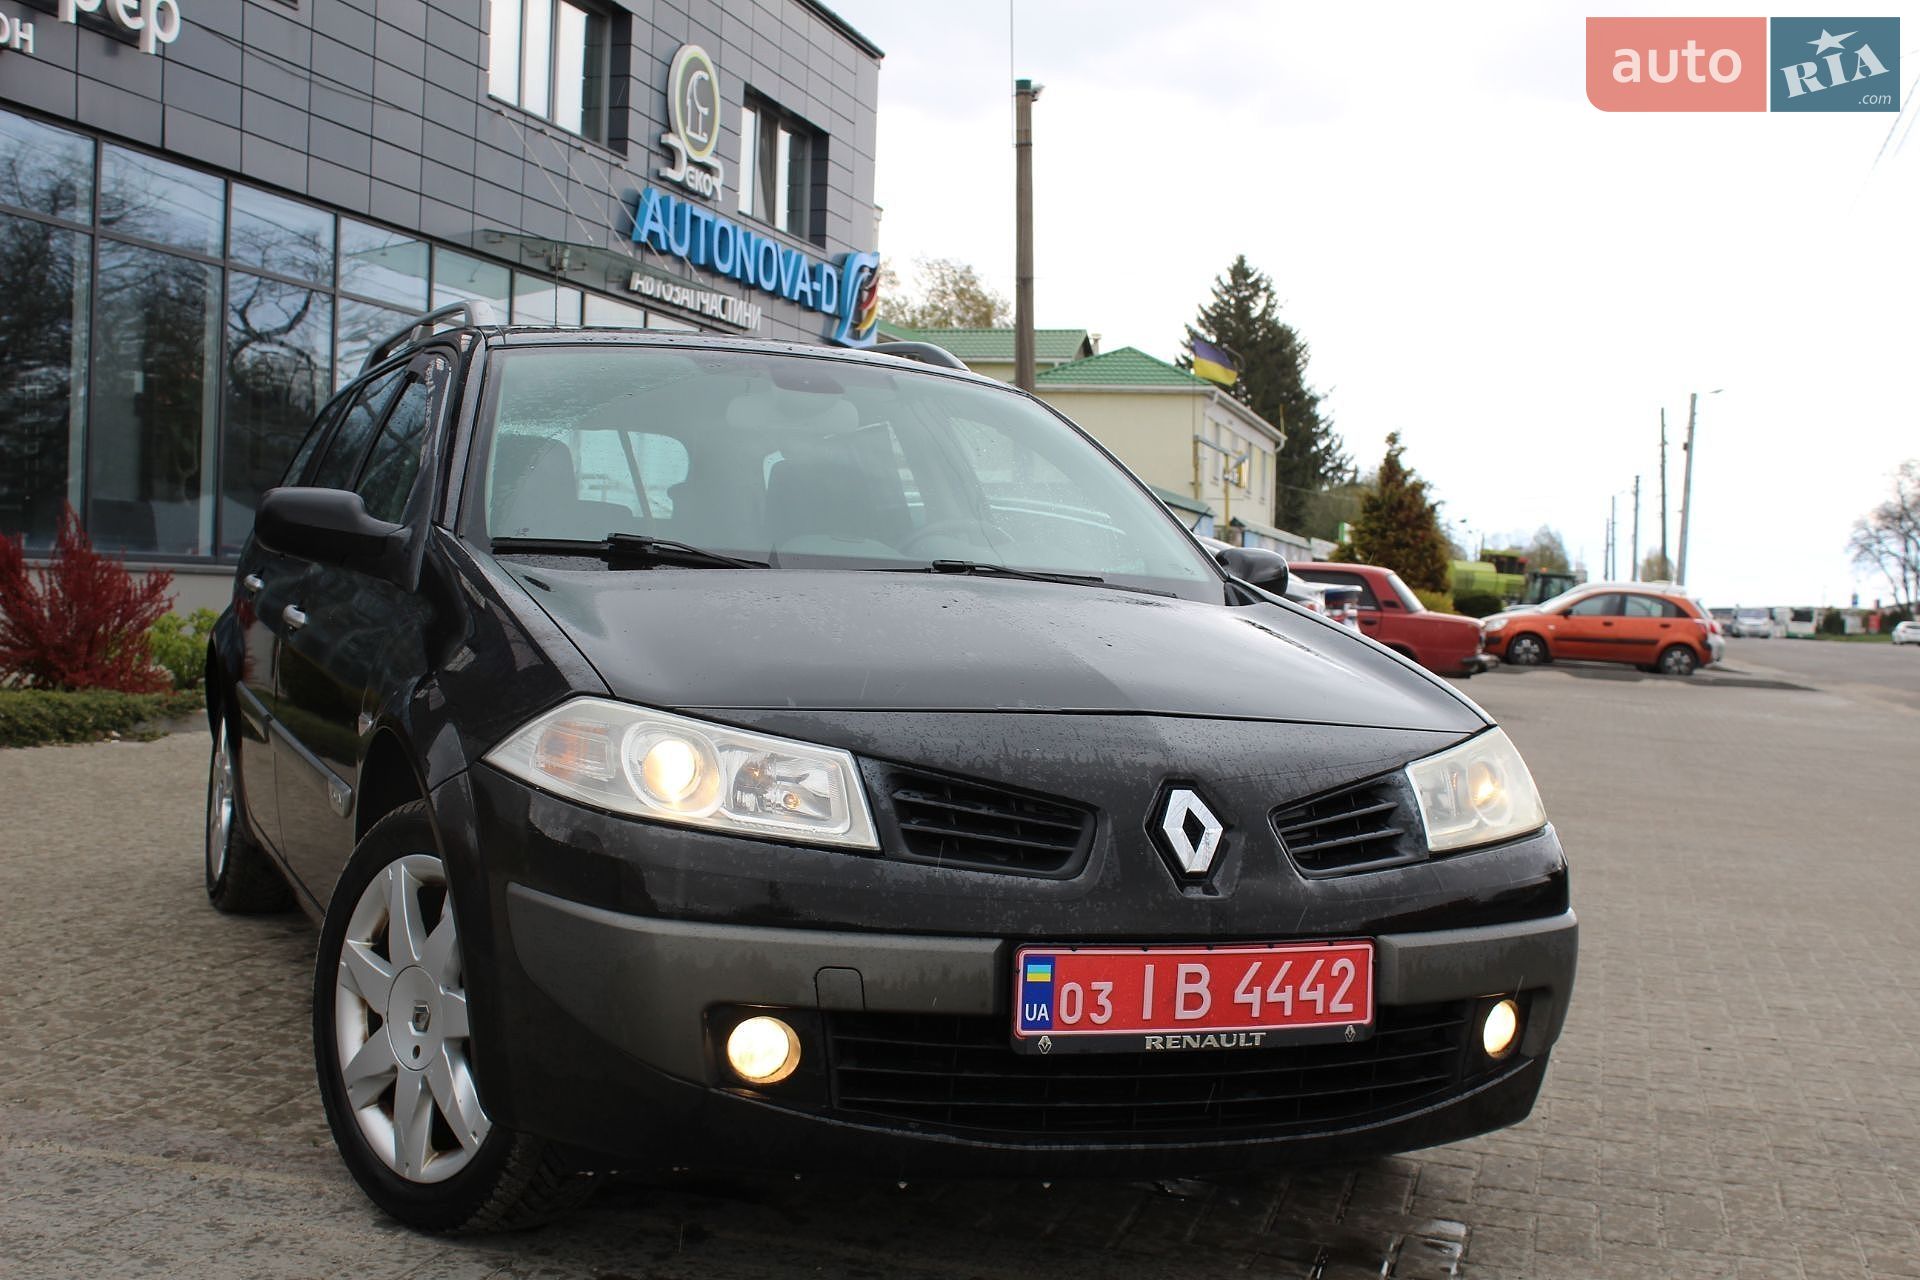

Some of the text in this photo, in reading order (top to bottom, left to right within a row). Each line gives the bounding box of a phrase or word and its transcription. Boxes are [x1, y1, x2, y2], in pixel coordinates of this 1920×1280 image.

[632, 187, 838, 315] AUTONOVA-D
[1025, 1003, 1050, 1022] UA
[1059, 982, 1114, 1025] 03
[1234, 958, 1356, 1018] 4442
[1144, 1031, 1267, 1051] RENAULT
